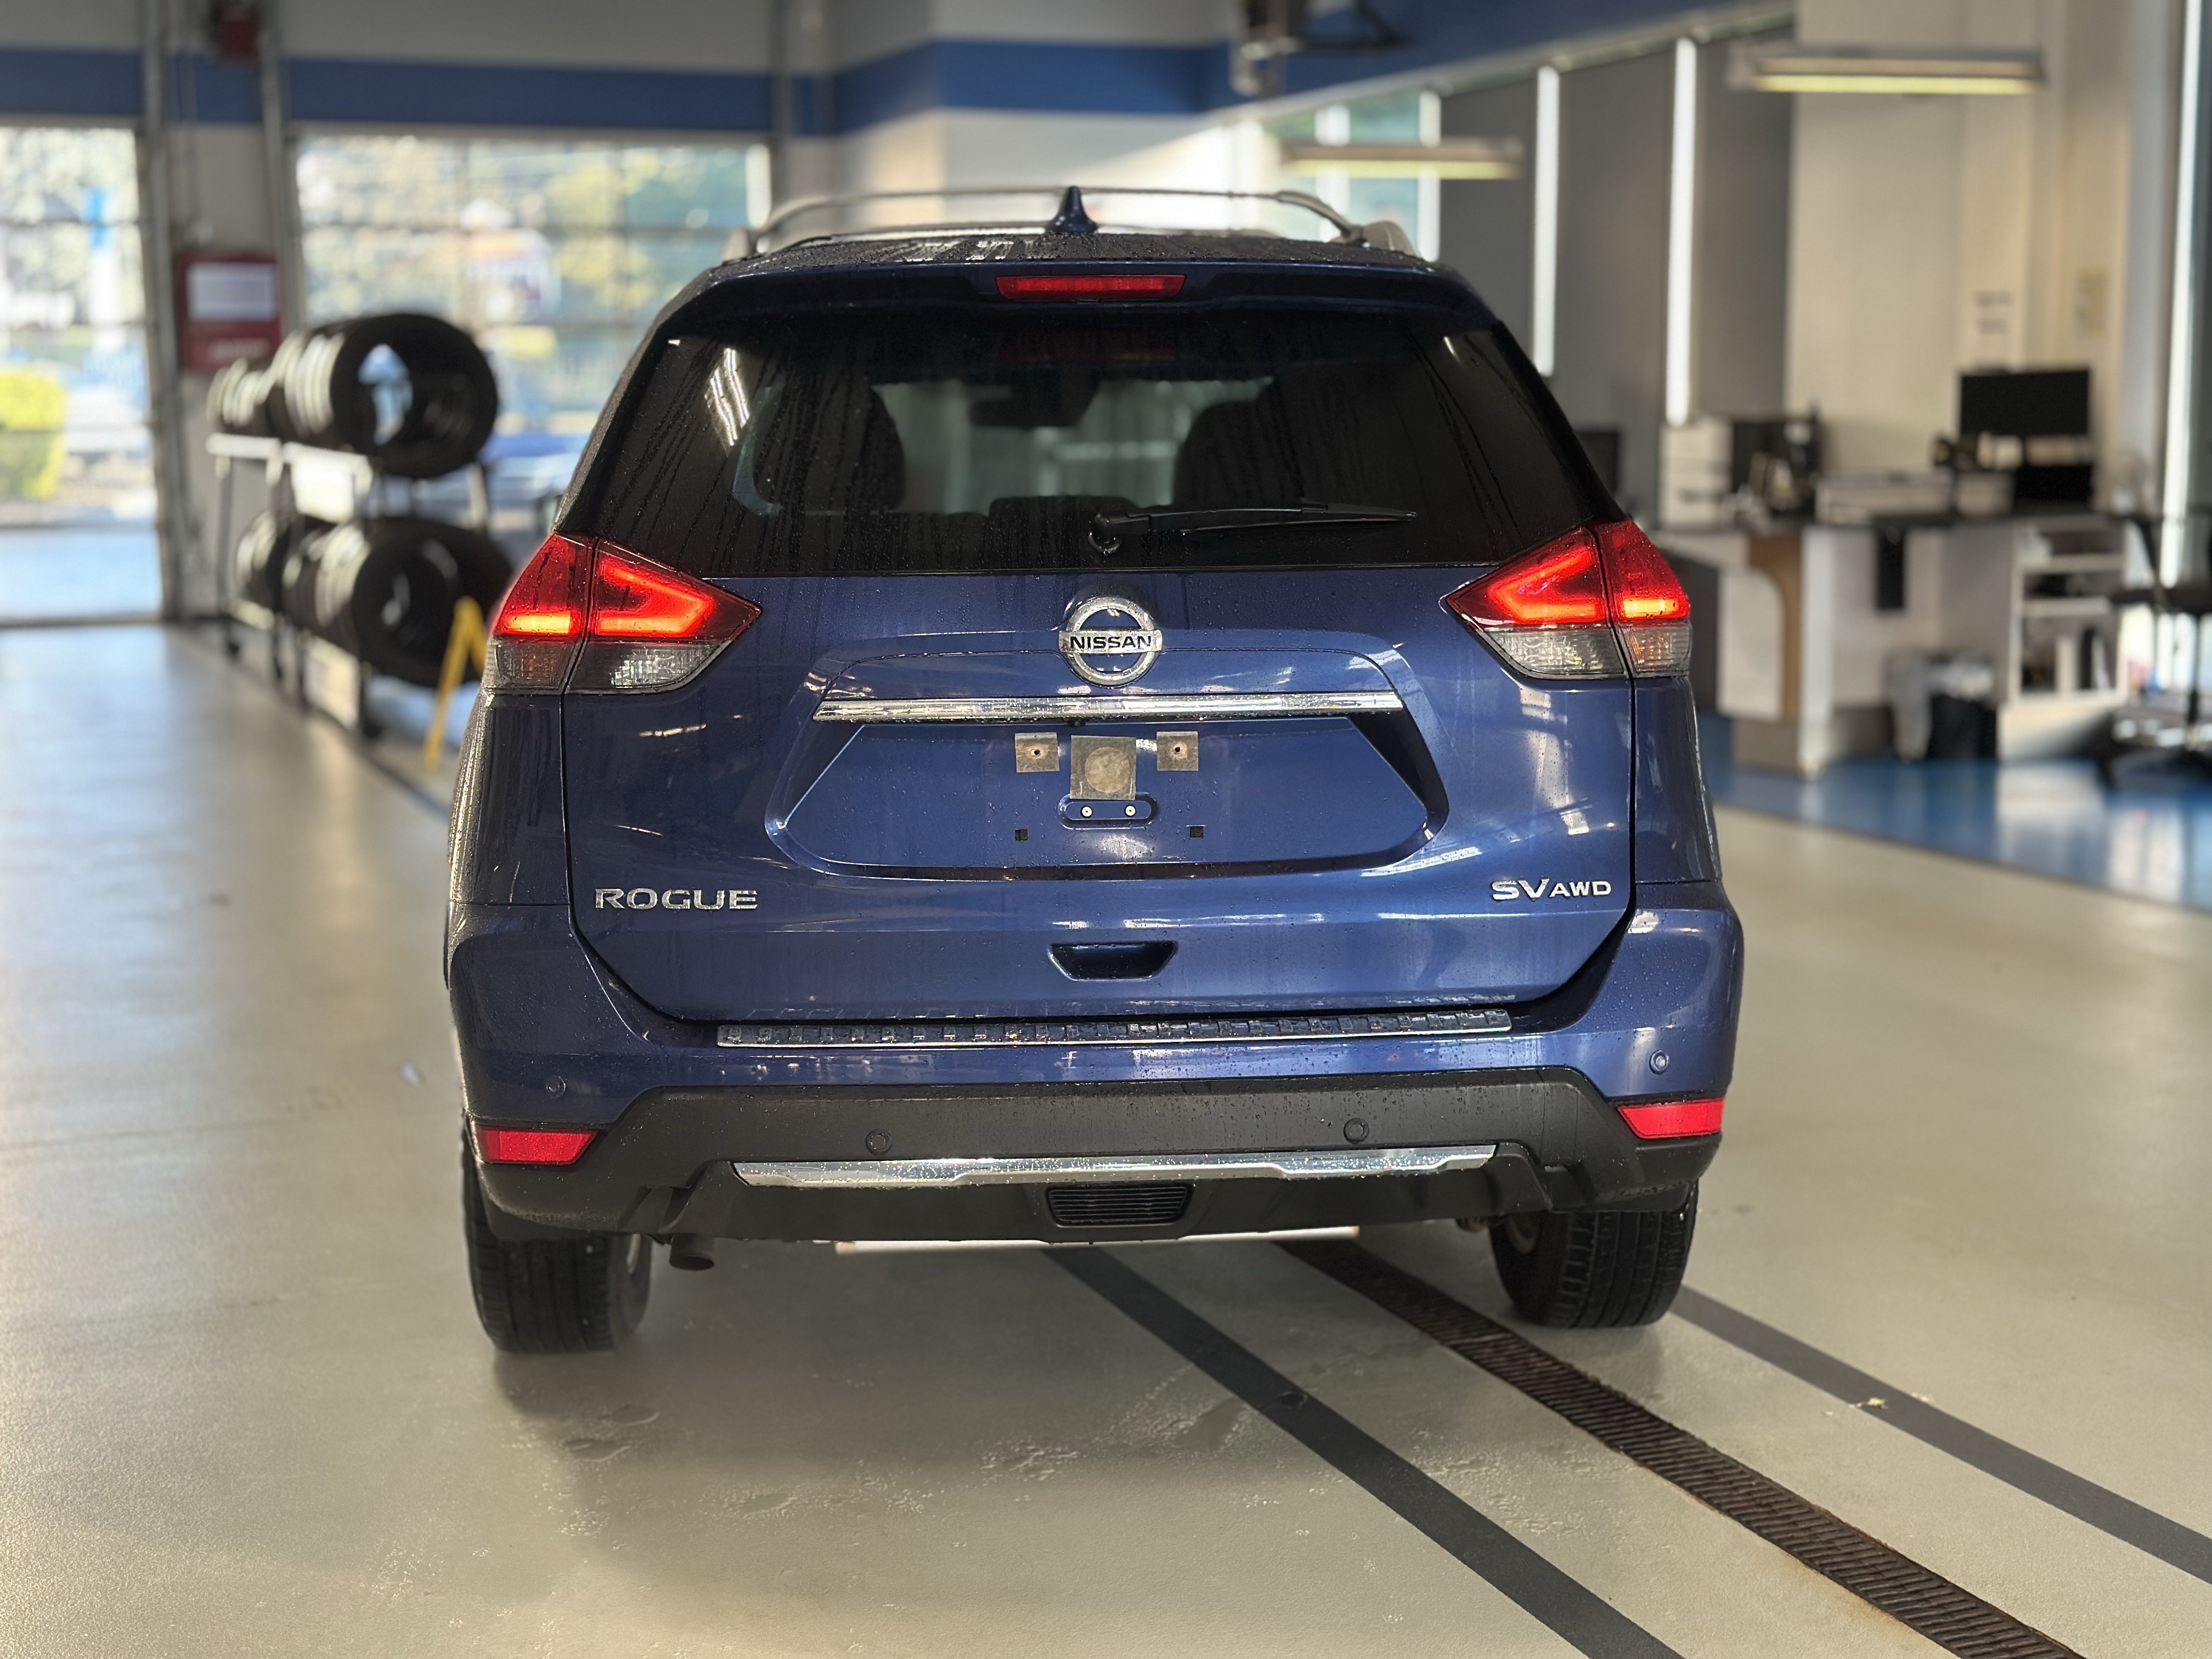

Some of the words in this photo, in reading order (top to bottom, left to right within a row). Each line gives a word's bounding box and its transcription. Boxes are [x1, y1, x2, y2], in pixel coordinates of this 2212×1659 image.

[1070, 636, 1151, 649] NISSAN
[595, 888, 758, 910] ROGUE
[1492, 878, 1550, 900] SV
[1549, 881, 1611, 898] AWD
